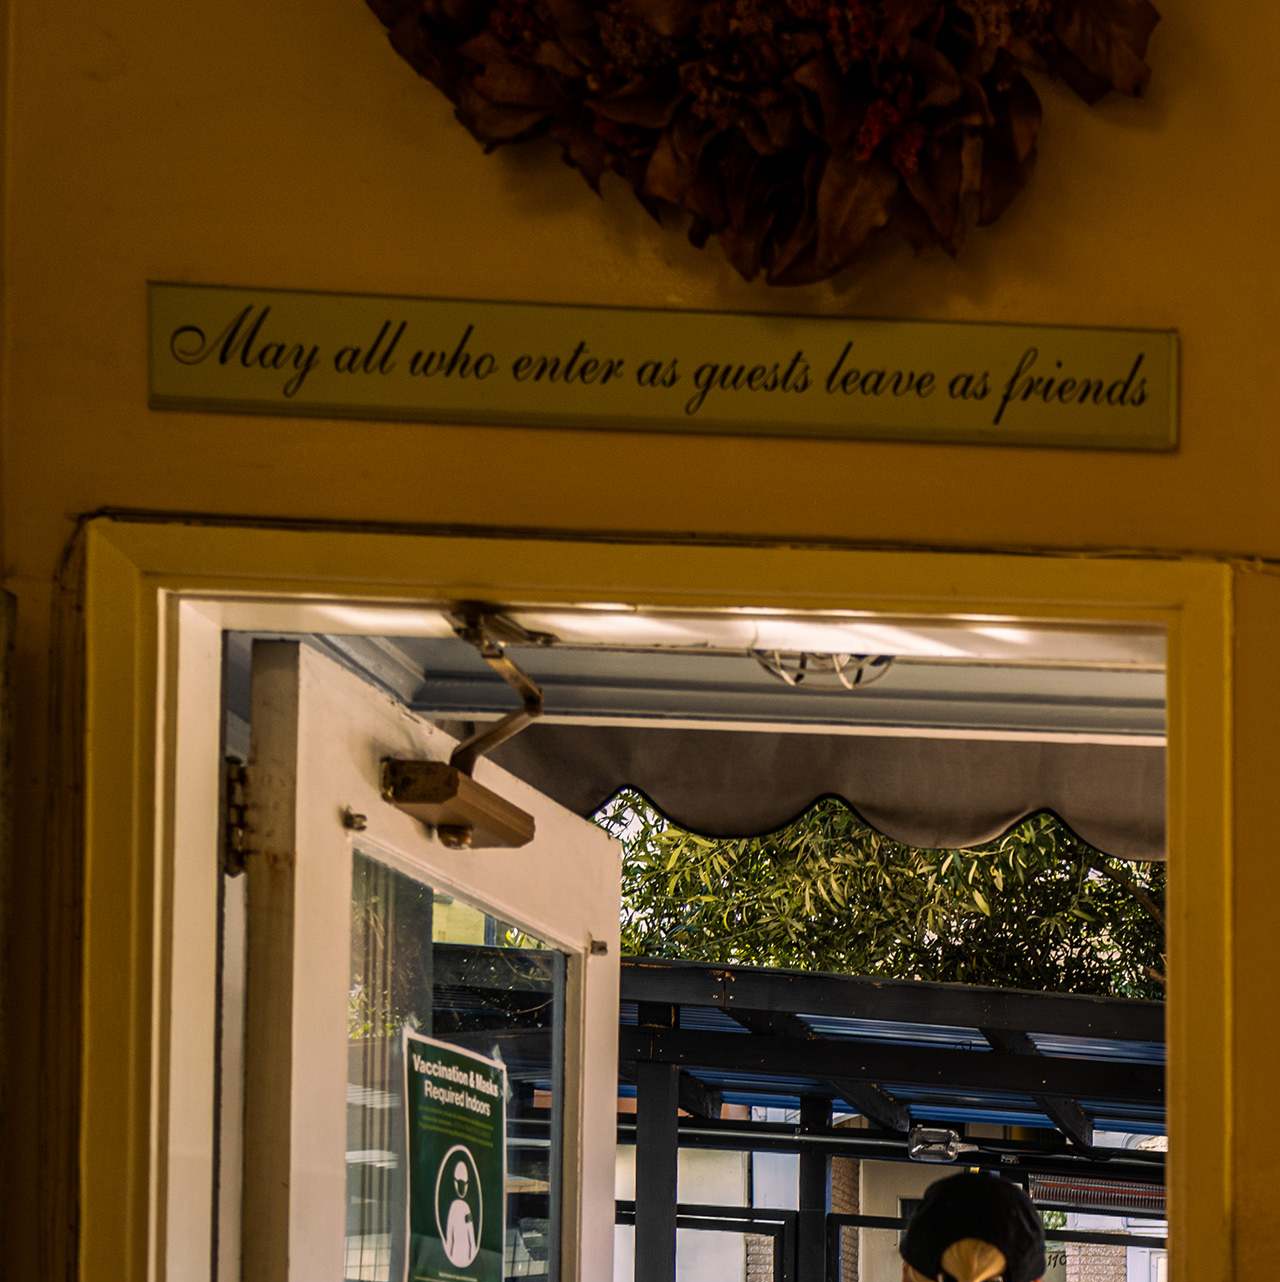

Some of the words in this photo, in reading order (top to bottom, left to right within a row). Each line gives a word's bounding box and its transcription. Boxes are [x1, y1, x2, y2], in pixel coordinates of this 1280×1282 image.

[169, 304, 320, 398] May
[333, 319, 407, 375] all
[409, 324, 498, 380] who
[512, 340, 624, 383] enter
[636, 358, 681, 389] as
[685, 350, 812, 415] guests
[825, 340, 935, 397] leave
[948, 367, 992, 401] as
[993, 346, 1150, 426] friends
[413, 1053, 469, 1086] Vaccination
[469, 1070, 475, 1089] &
[475, 1073, 499, 1098] Masks
[424, 1079, 464, 1105] Required
[465, 1091, 491, 1117] Indoors
